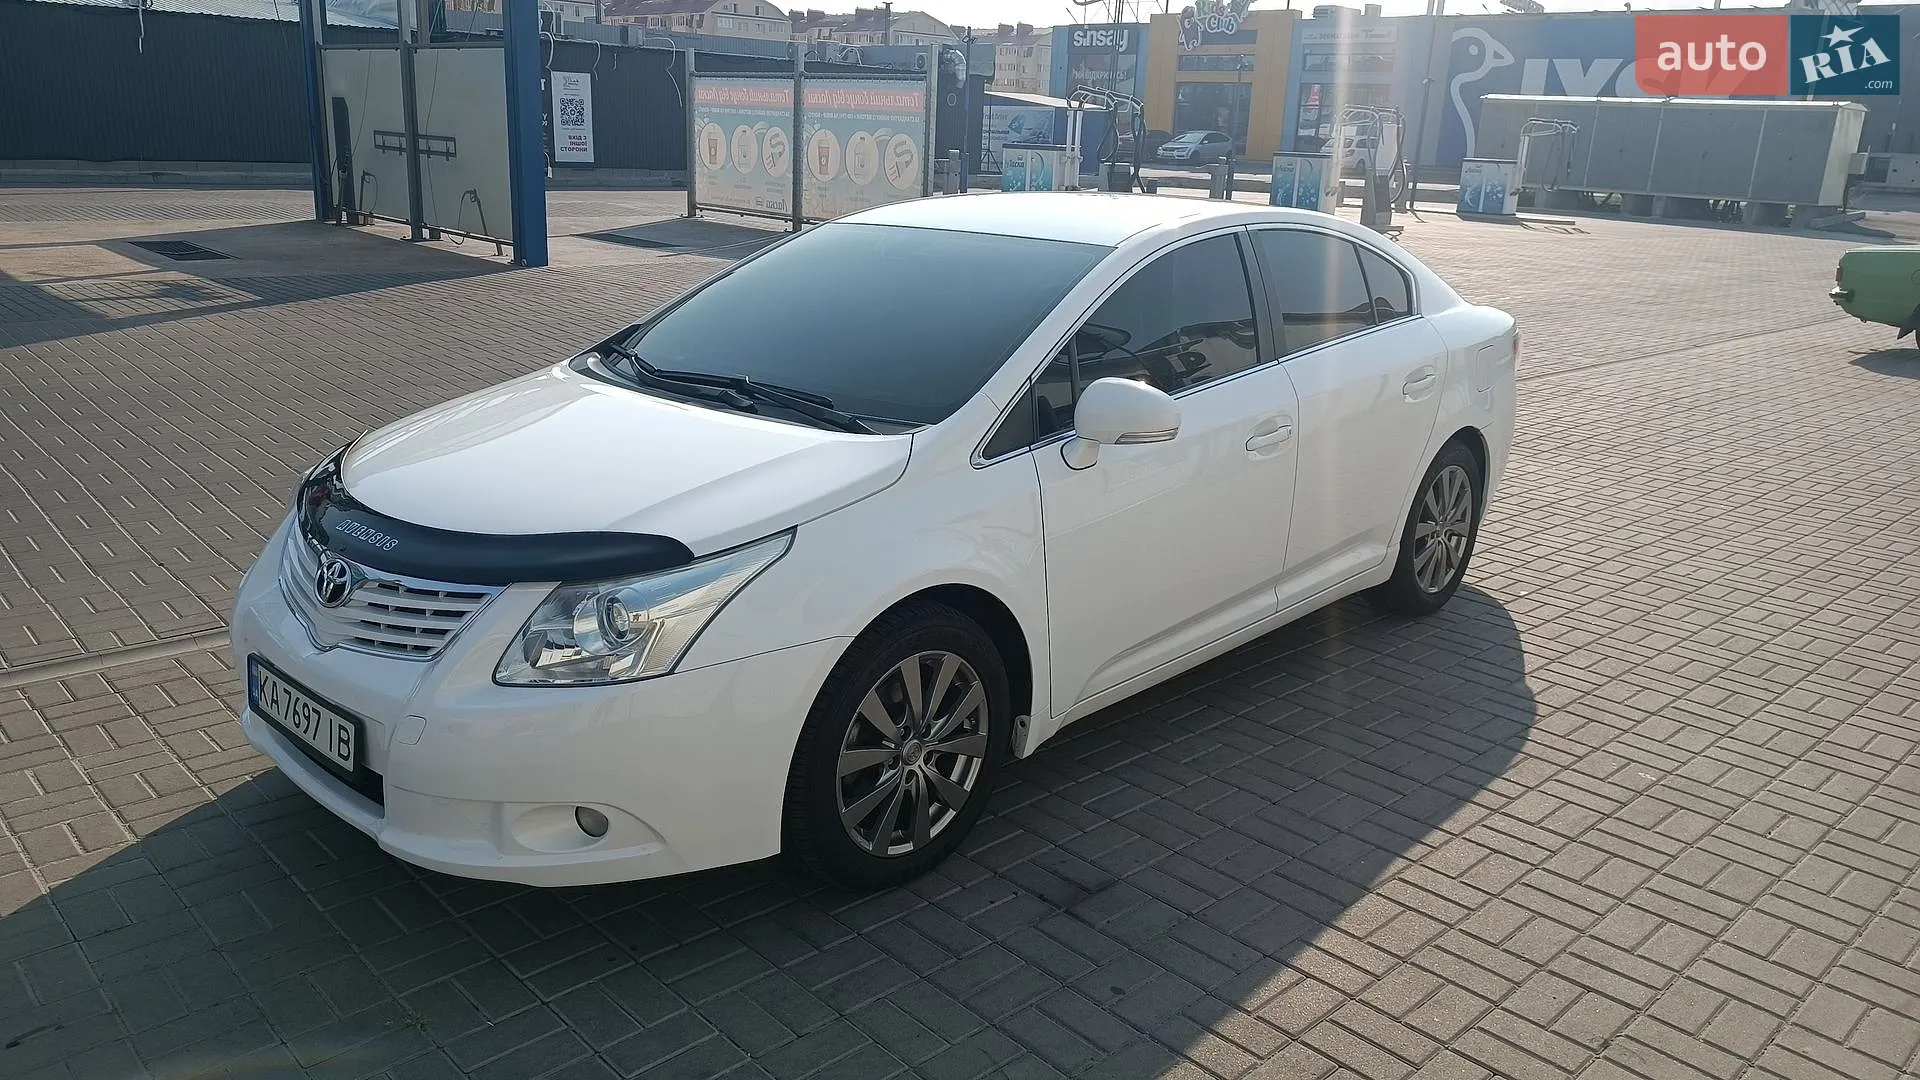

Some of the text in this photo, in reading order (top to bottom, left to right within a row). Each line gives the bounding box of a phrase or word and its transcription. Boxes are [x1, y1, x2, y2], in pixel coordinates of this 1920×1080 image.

[1207, 15, 1235, 33] Club
[1073, 25, 1129, 52] sinsay
[336, 519, 399, 551] AVENSIS
